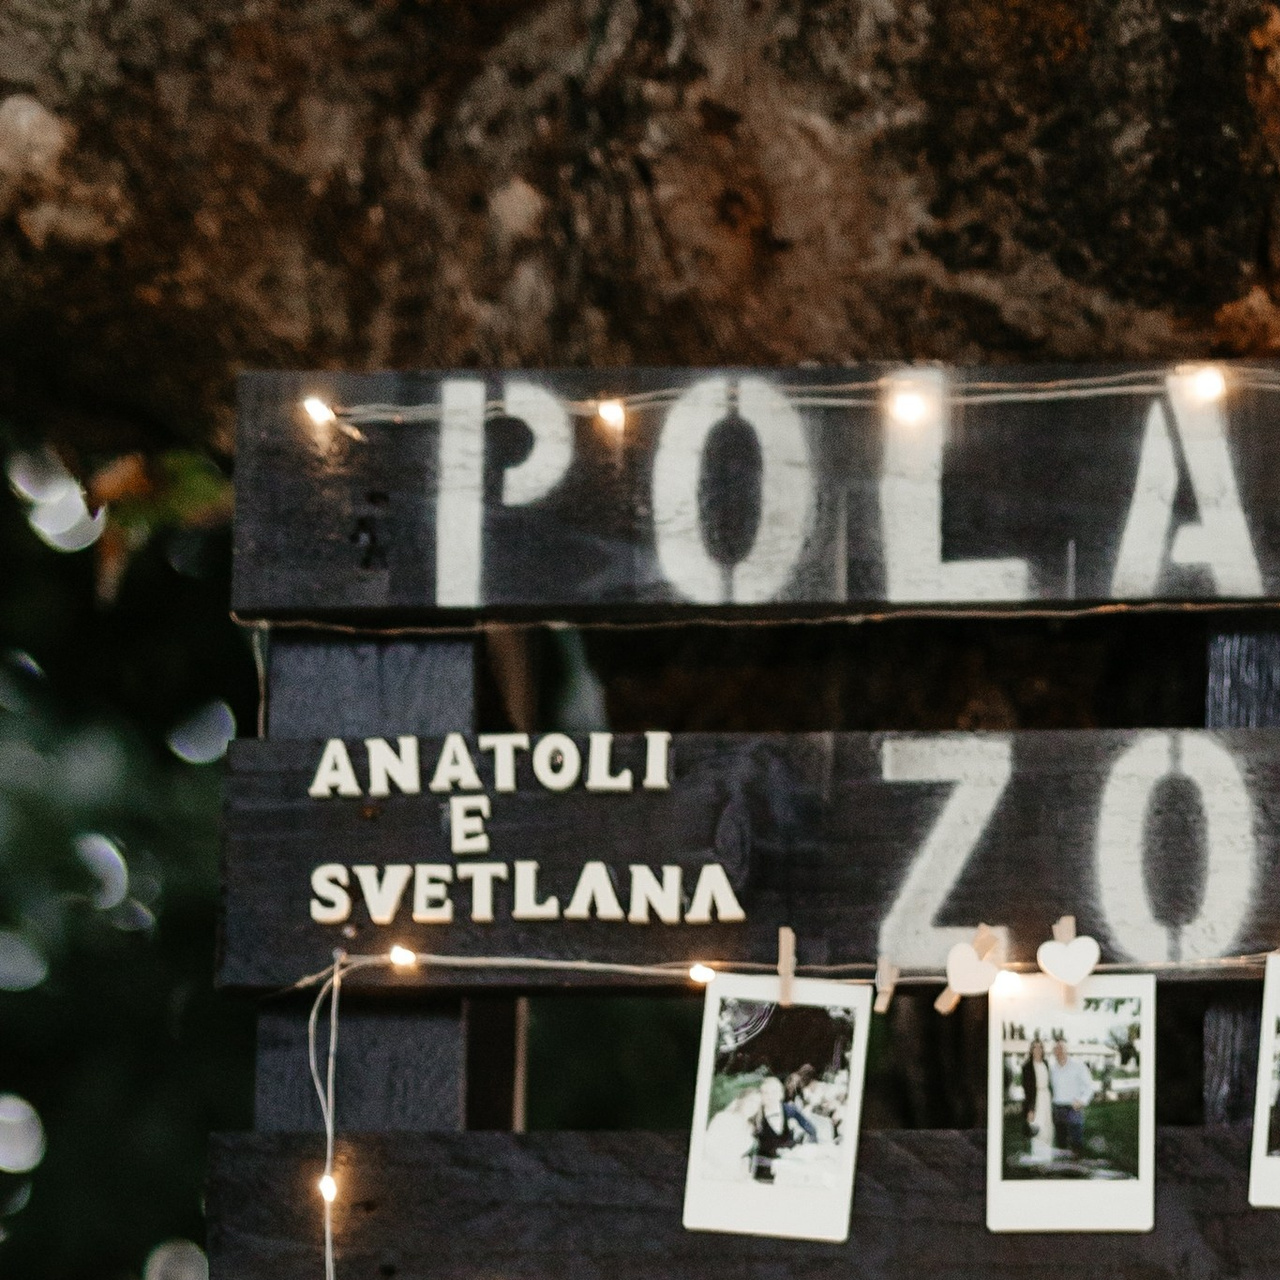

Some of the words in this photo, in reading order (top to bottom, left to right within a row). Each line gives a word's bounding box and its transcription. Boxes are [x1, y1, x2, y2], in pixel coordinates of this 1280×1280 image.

[307, 730, 673, 798] ANATOLI
[449, 794, 491, 855] E
[308, 860, 747, 925] SVETLANA
